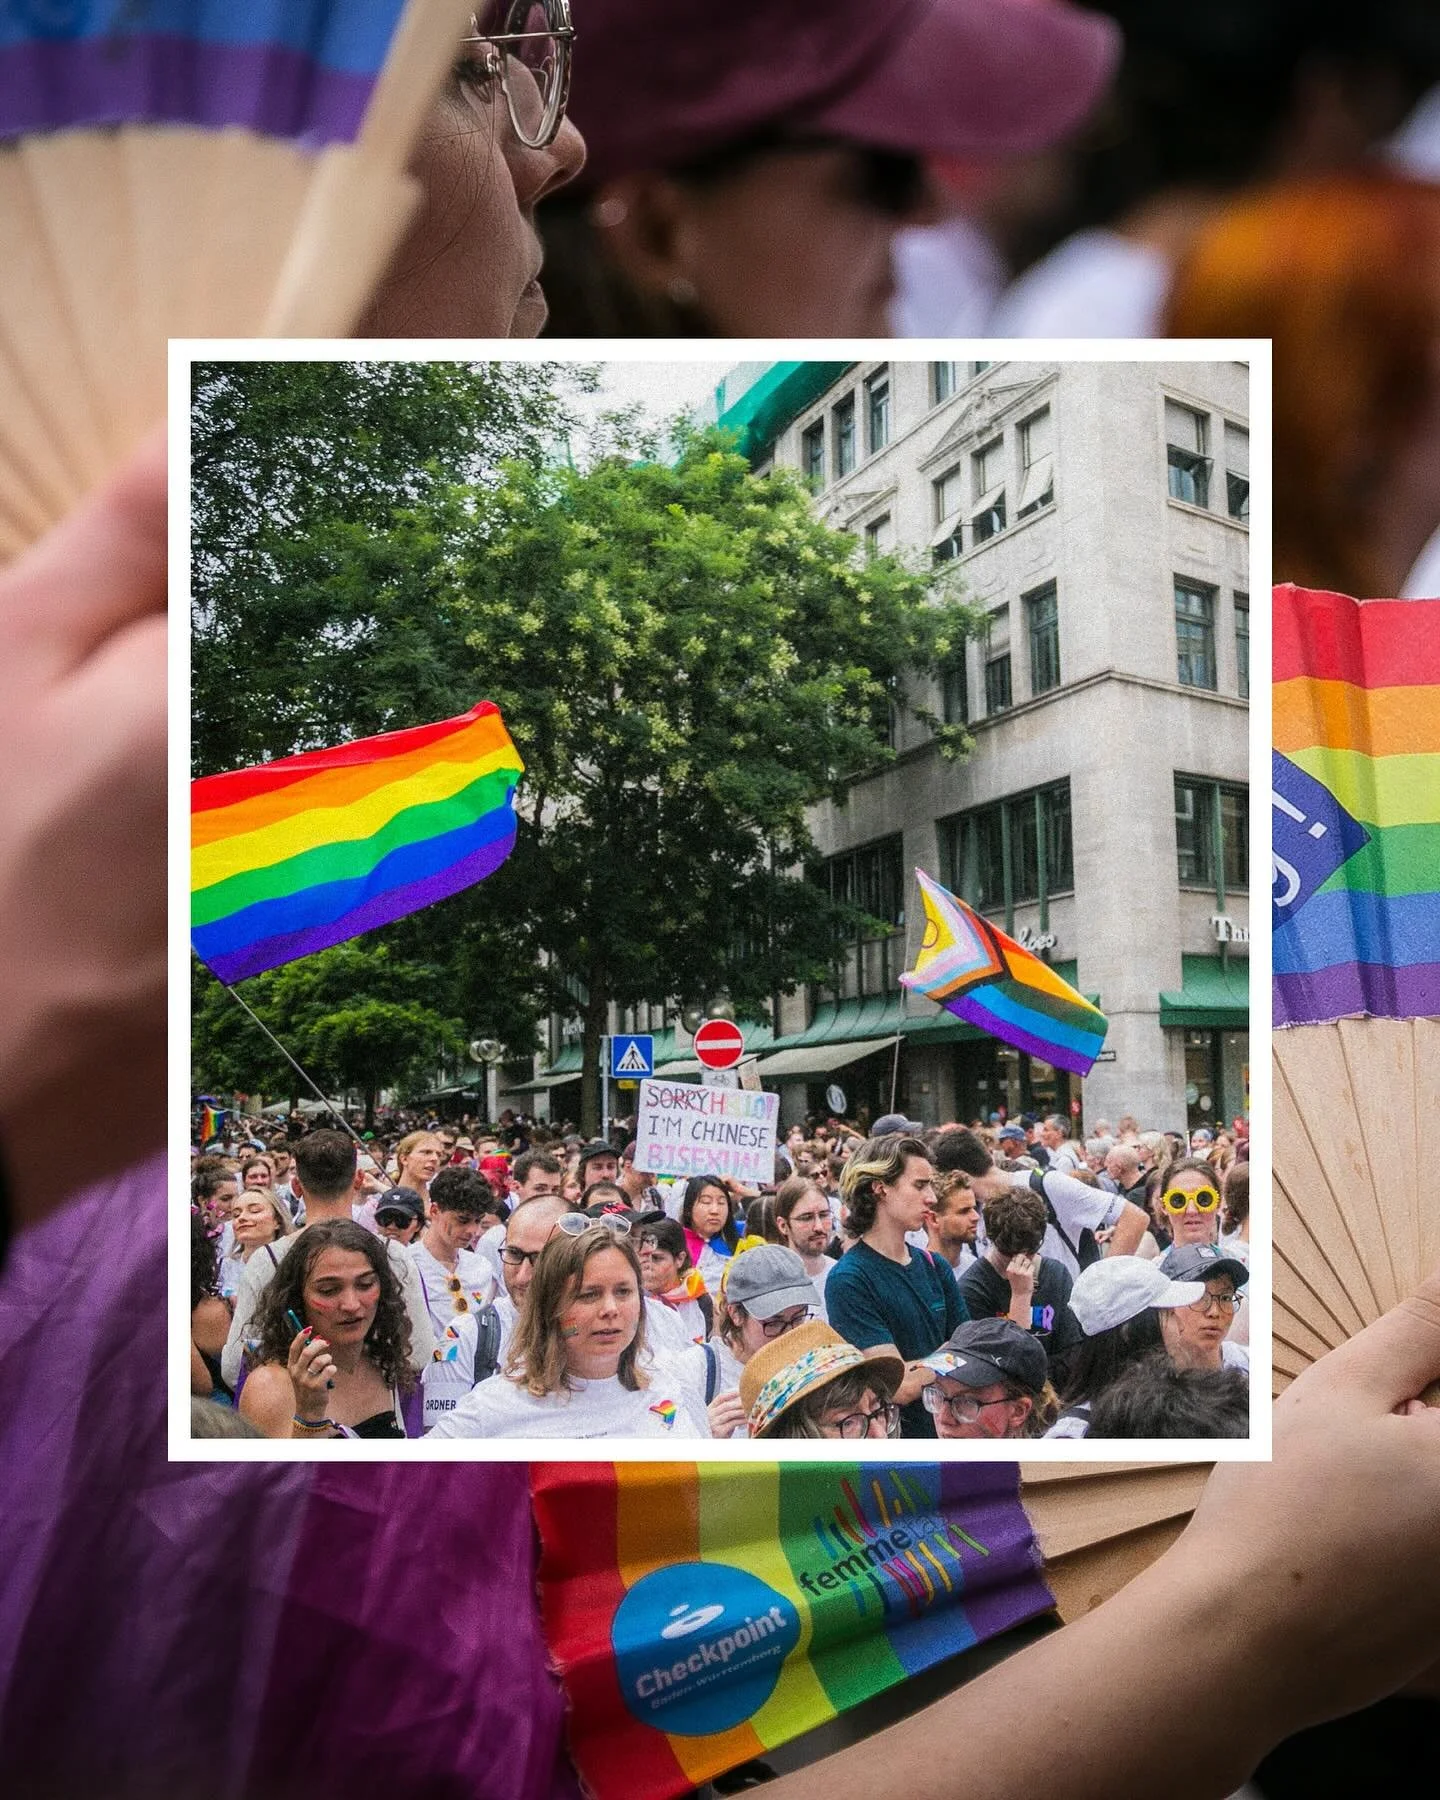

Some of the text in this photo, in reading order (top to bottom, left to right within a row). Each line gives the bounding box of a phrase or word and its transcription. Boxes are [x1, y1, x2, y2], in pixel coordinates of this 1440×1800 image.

[646, 1085, 709, 1111] SORRY
[648, 1115, 769, 1149] I'M CHINESE
[425, 1399, 457, 1411] ORDNER
[635, 1605, 788, 1699] Checkpoint
